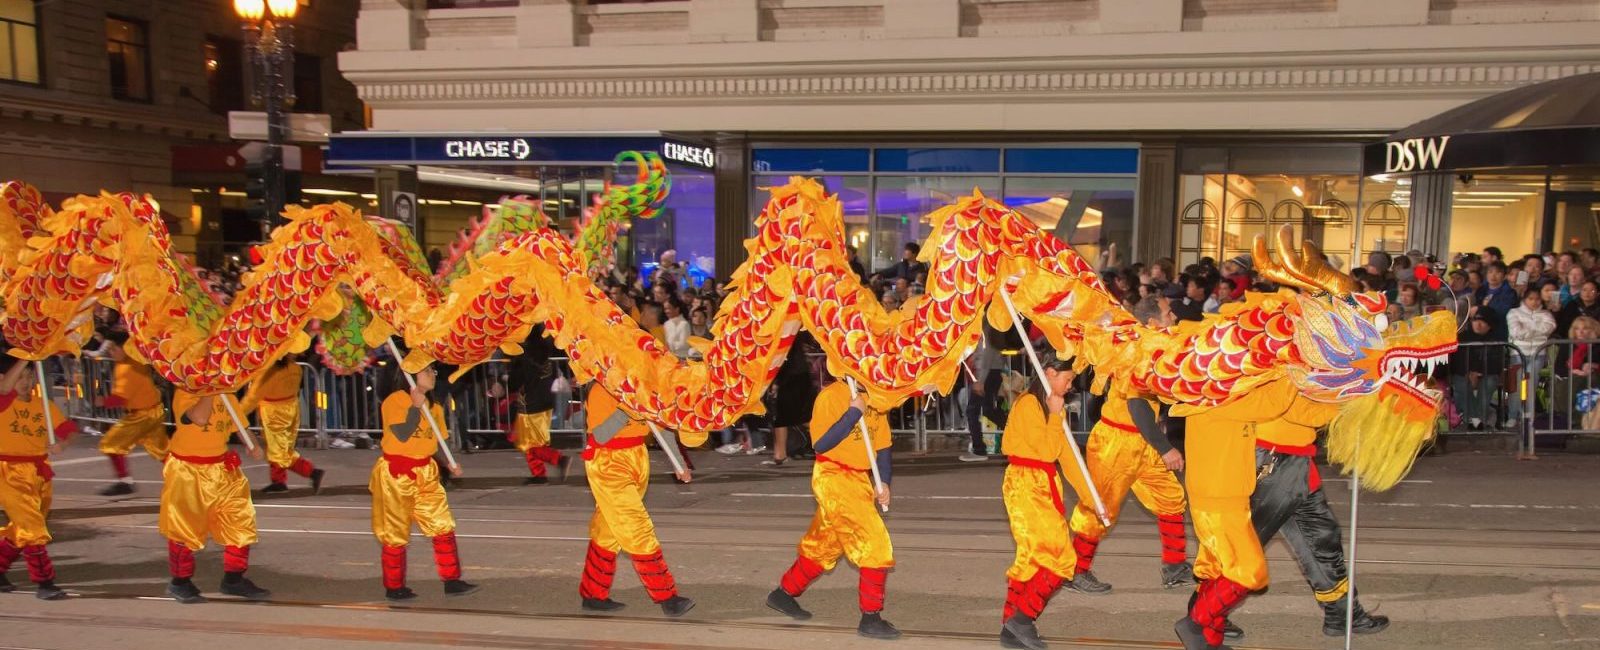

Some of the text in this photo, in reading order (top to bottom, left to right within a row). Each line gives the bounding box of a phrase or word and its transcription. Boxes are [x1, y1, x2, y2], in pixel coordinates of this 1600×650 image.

[446, 141, 510, 158] CHASE
[664, 142, 704, 165] CHASE
[1385, 136, 1451, 173] DSW
